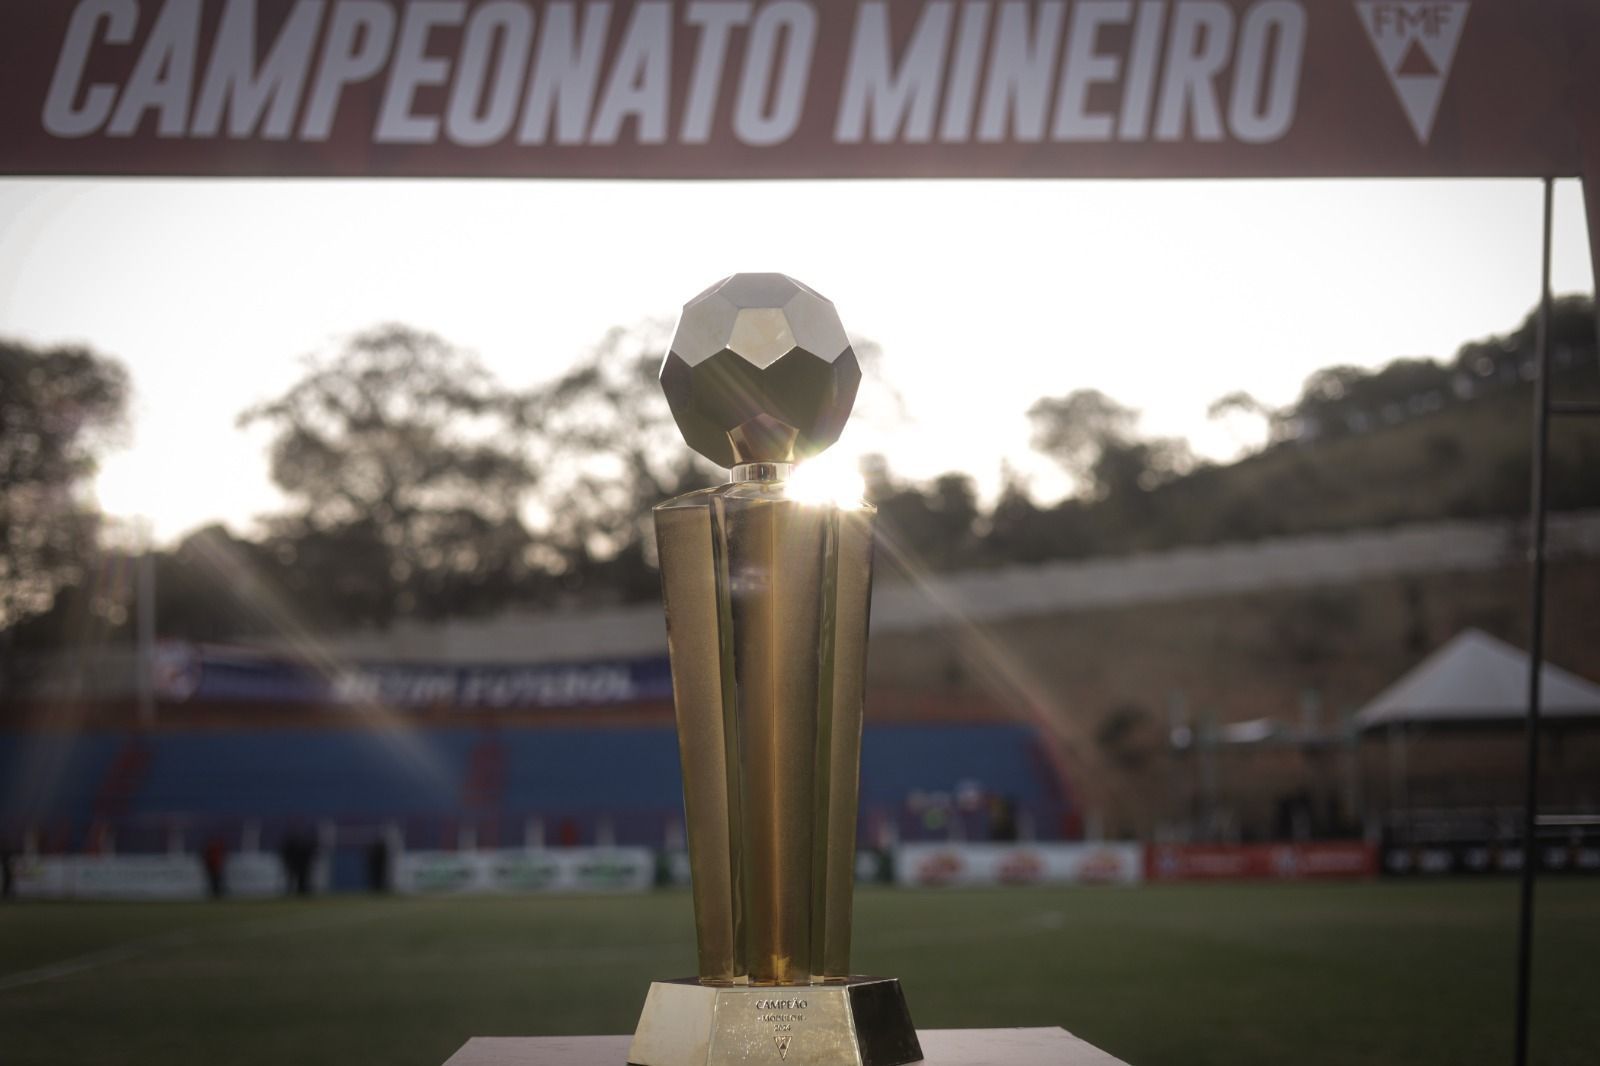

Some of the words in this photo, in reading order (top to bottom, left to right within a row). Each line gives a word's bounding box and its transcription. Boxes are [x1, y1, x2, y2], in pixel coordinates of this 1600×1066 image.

[1373, 4, 1453, 37] FMF
[42, 0, 817, 146] CAMPEONATO
[834, 0, 1307, 142] MINEIRO
[756, 997, 808, 1010] CAMPEÃO
